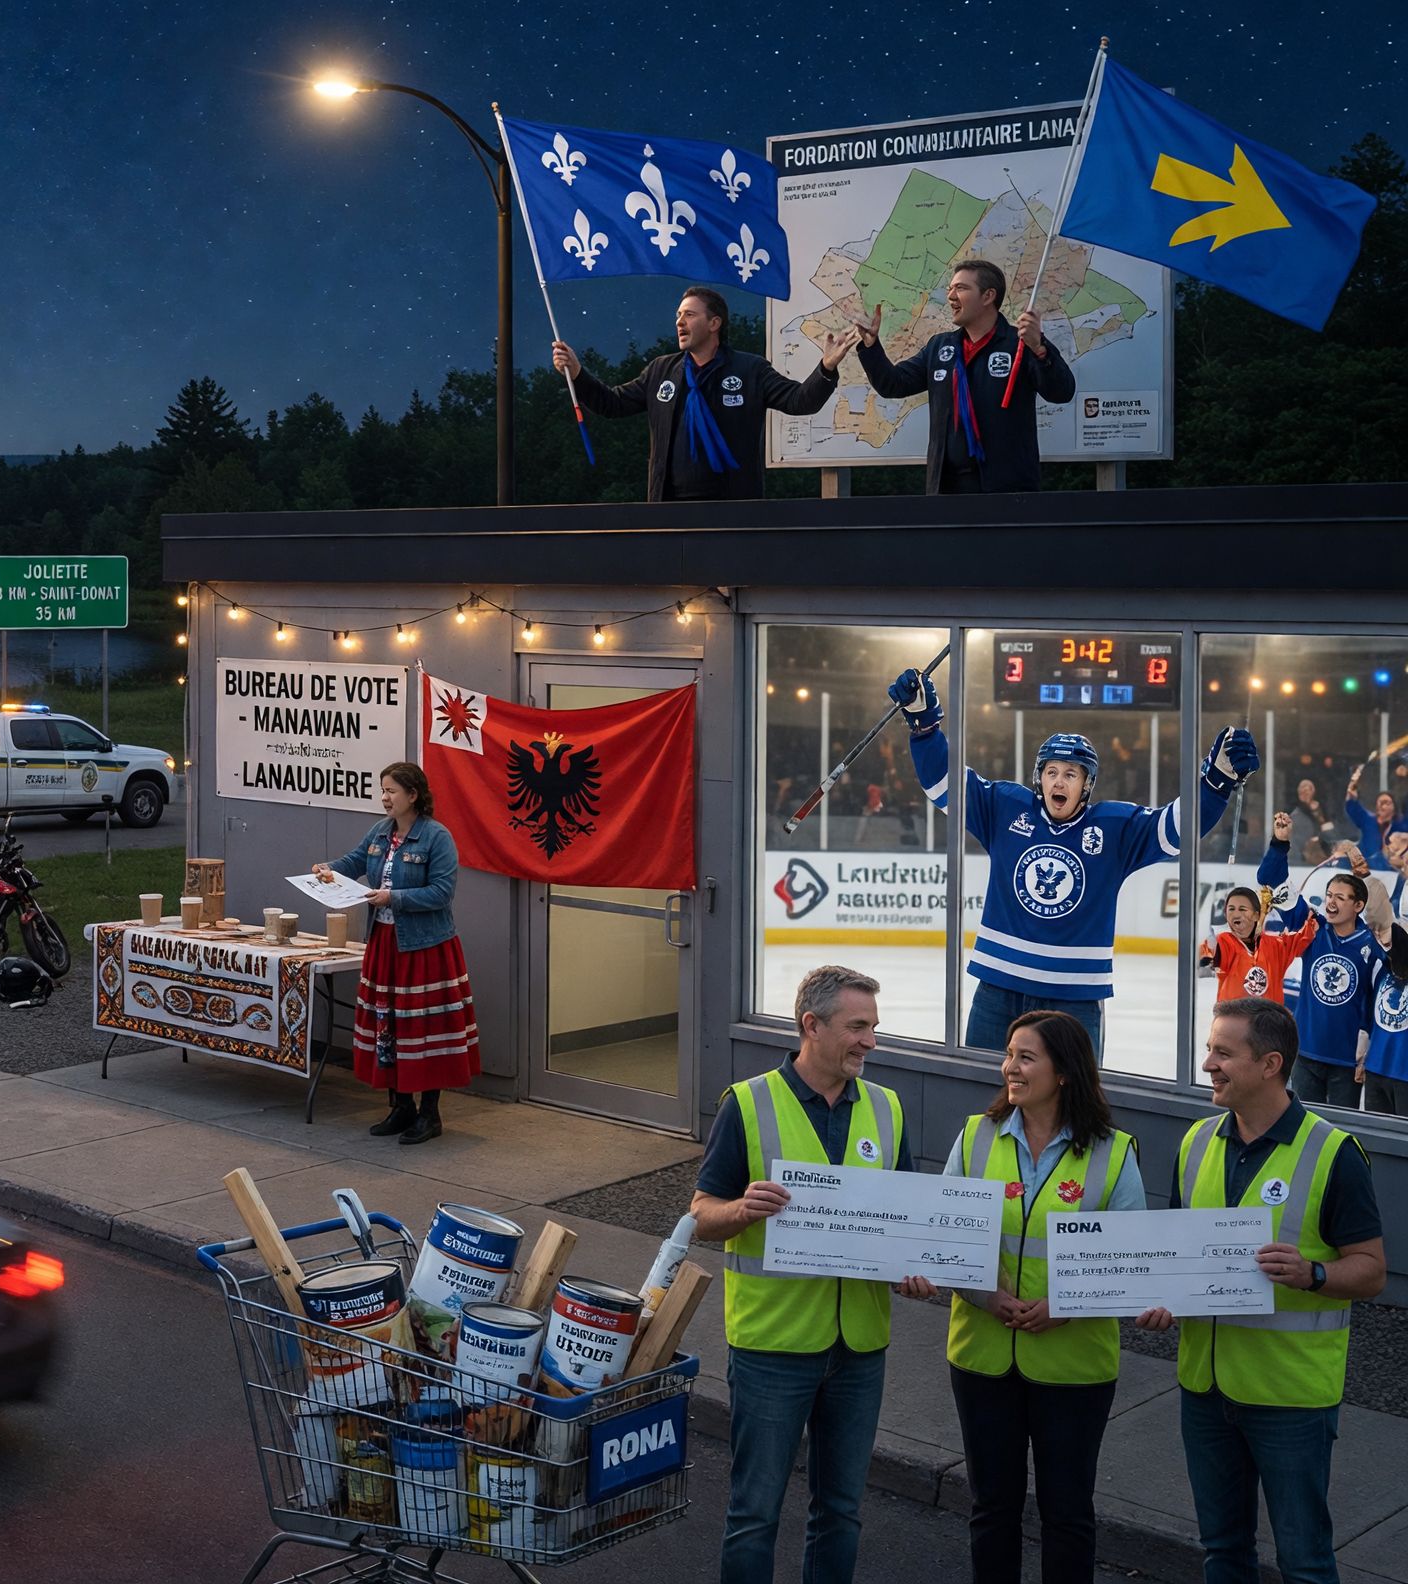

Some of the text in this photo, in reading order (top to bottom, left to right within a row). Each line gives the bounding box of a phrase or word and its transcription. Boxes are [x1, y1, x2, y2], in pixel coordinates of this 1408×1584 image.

[1029, 116, 1081, 142] LANA
[23, 564, 88, 579] JOLIETTE
[8, 586, 27, 600] KM
[40, 586, 121, 600] SAINT-DONAT
[35, 606, 76, 621] 35 KM
[225, 669, 399, 706] BUREAU DE VOTE
[254, 705, 361, 740] MANAWAN
[243, 761, 373, 800] LANAUDIÈRE
[1056, 1221, 1103, 1234] RONA
[602, 1418, 677, 1470] RONA
